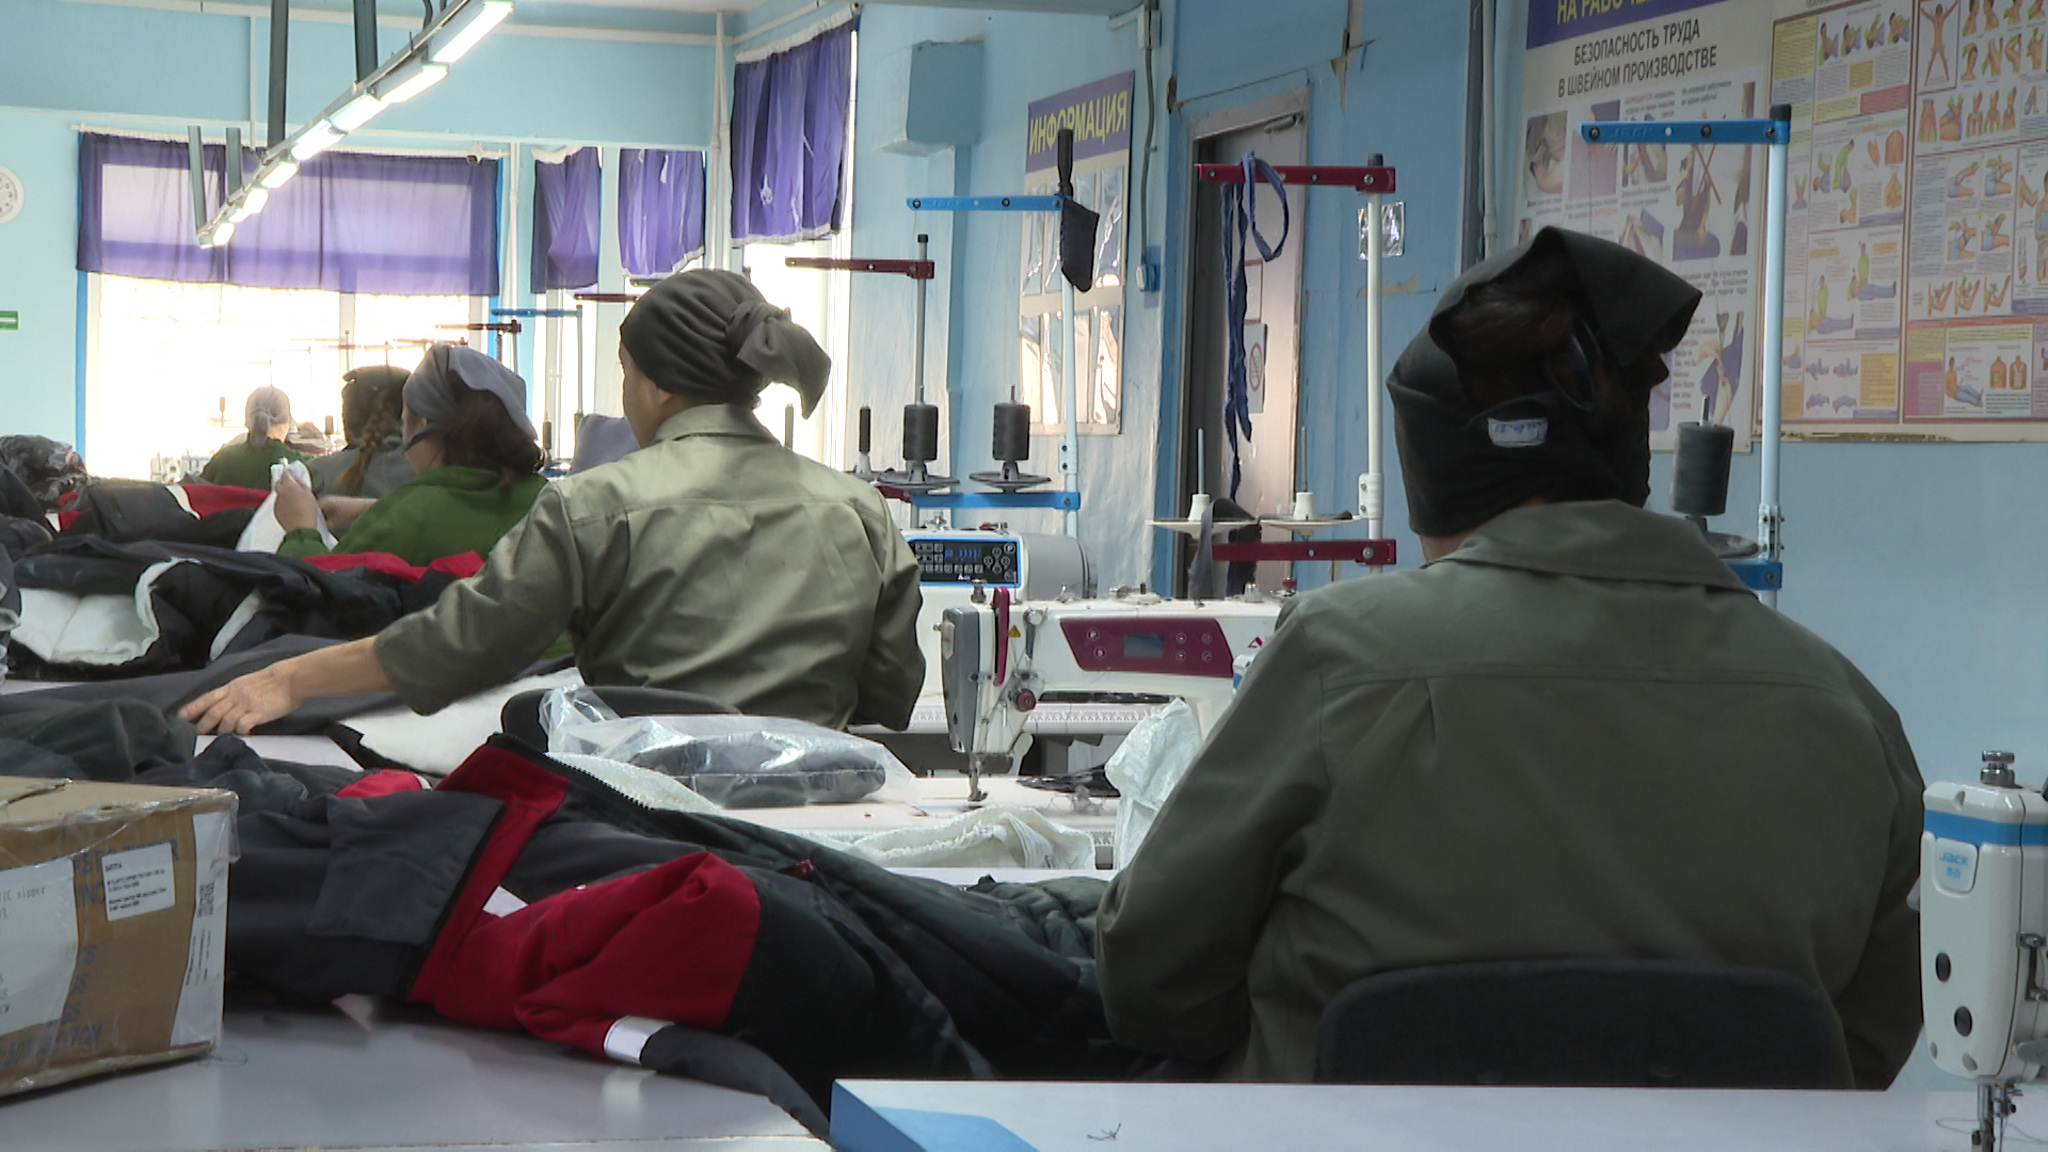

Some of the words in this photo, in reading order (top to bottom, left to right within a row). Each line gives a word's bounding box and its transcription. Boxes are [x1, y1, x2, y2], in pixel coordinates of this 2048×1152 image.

[1574, 28, 1660, 66] БЕЗОПАСНОСТЬ
[1663, 18, 1700, 46] ТРУДА
[1558, 78, 1565, 98] В
[1567, 65, 1621, 96] ШВЕЙНОМ
[1623, 45, 1718, 85] ПРОИЗВОДСТВЕ
[1028, 90, 1128, 155] ИНФОРМАЦИЯ
